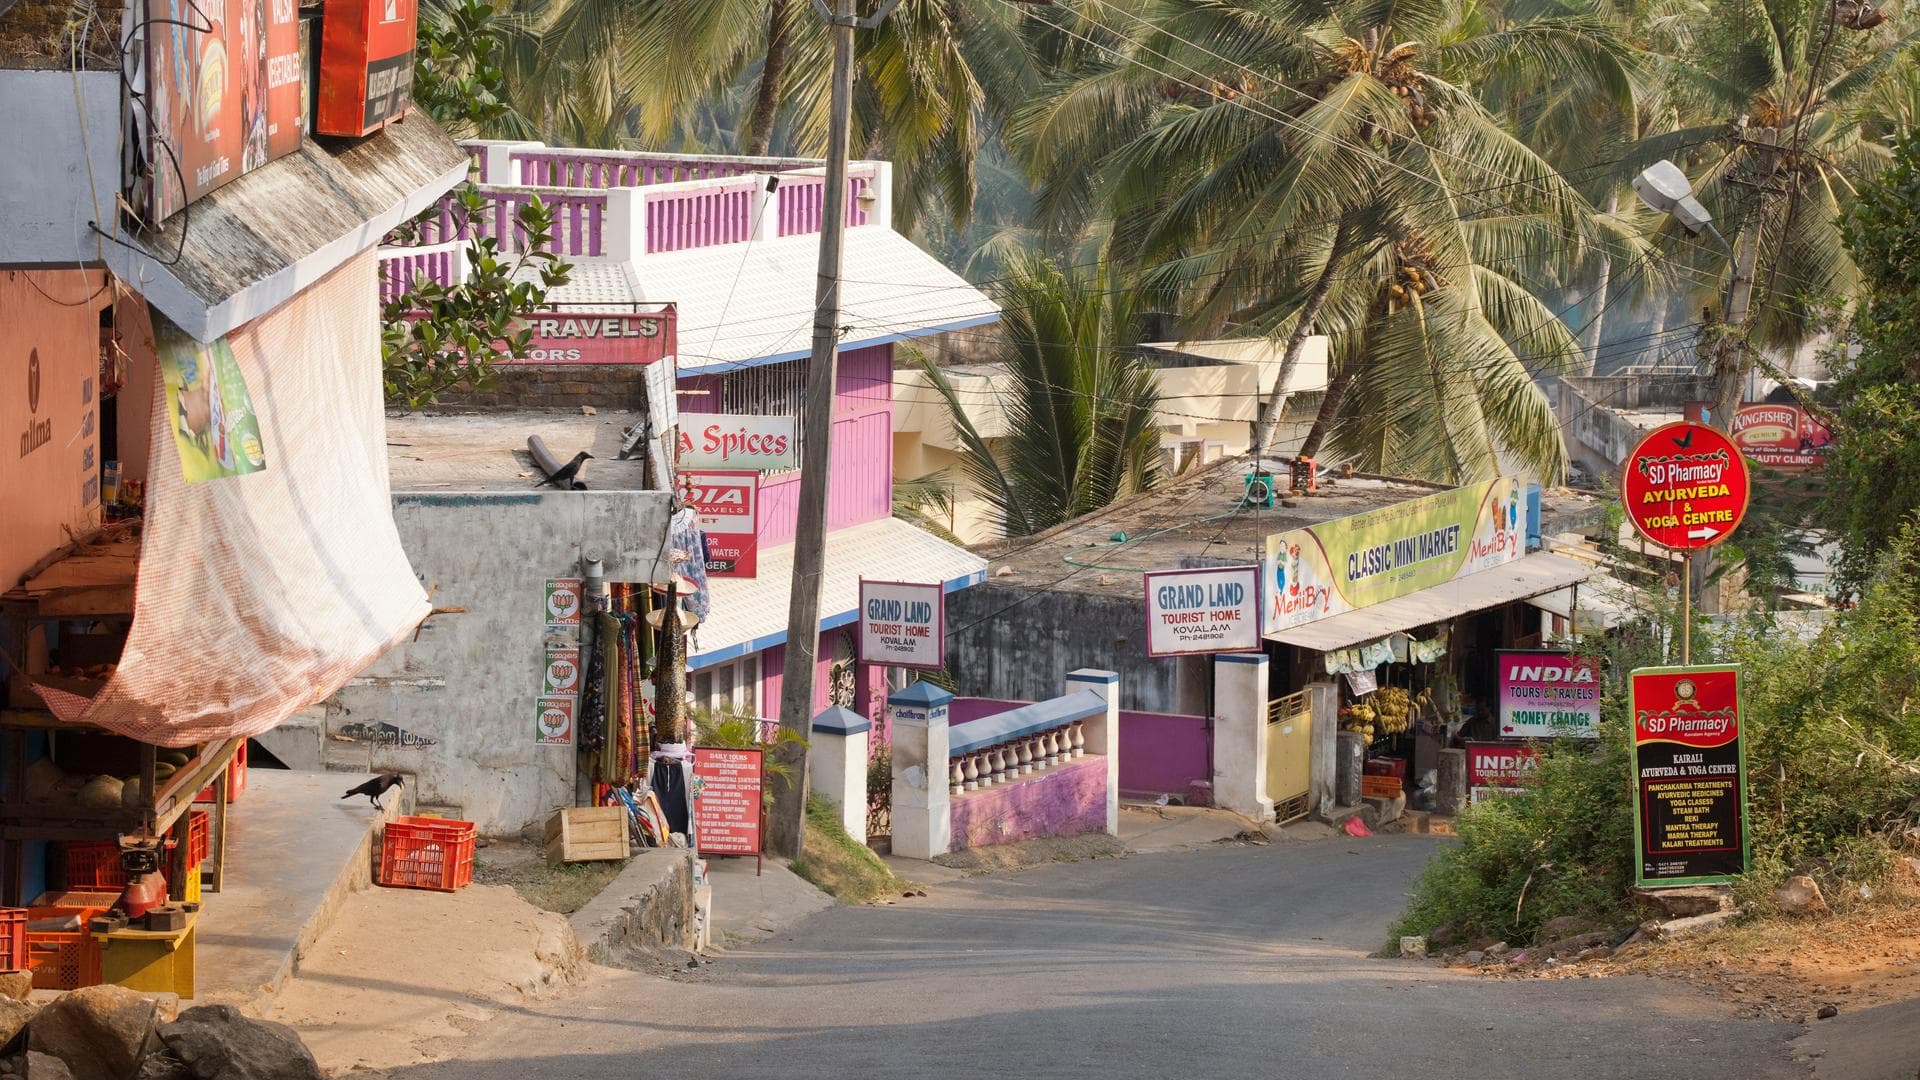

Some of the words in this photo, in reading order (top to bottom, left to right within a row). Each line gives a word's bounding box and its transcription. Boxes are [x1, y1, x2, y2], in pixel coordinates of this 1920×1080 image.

[268, 52, 300, 89] VEGETABLES
[527, 319, 658, 338] TRAVELS
[1735, 411, 1793, 430] KINGFISHER
[20, 417, 52, 459] milma
[703, 425, 788, 461] Spices
[1746, 454, 1782, 463] EAUTY
[1783, 456, 1814, 464] CLINIC
[1649, 464, 1665, 484] SD
[1668, 463, 1723, 482] Pharmacy
[681, 488, 743, 505] DIA
[1643, 484, 1730, 504] AYURVEDA
[1684, 502, 1692, 512] &
[1644, 515, 1680, 529] YOGA
[1683, 510, 1733, 526] CENTRE
[711, 549, 740, 557] WATER
[1348, 544, 1391, 582] CLASSIC
[1394, 536, 1416, 568] MINI
[1419, 525, 1460, 561] MARKET
[1158, 584, 1204, 610] GRAND
[1209, 582, 1244, 607] LAND
[868, 599, 902, 621] GRAND
[904, 600, 932, 624] LAND
[1161, 611, 1205, 625] TOURIST
[1210, 609, 1242, 622] HOME
[869, 623, 902, 636] TOURIST
[905, 626, 930, 638] HOME
[1173, 624, 1231, 634] KOVALAM
[880, 636, 916, 646] KOVALAM
[1509, 666, 1594, 683] INDIA
[1511, 687, 1540, 698] TOURS
[1554, 688, 1593, 700] TRAVELS
[1512, 710, 1547, 725] MONEY
[1551, 711, 1590, 726] CHANGE
[1649, 719, 1666, 732] SD
[1669, 717, 1729, 733] Pharmacy
[1475, 755, 1538, 770] INDIA
[1673, 754, 1703, 764] KAIRALI
[1475, 769, 1499, 777] TOURS
[1641, 767, 1678, 778] AYURVEDA
[1680, 766, 1687, 776] &
[1688, 766, 1707, 775] YOGA
[1708, 764, 1737, 774] CENTRE
[1648, 783, 1693, 791] PANCHAKARMA
[1694, 781, 1733, 789] TREATMENTS
[1657, 791, 1691, 799] AYURVEDIC
[1692, 789, 1724, 797] MEDICINES
[1694, 806, 1710, 814] BATH
[1665, 824, 1691, 832] MANTRA
[1692, 822, 1719, 831] THERAPY
[1685, 838, 1724, 847] TREATMENTS
[1690, 831, 1718, 839] THERAPY
